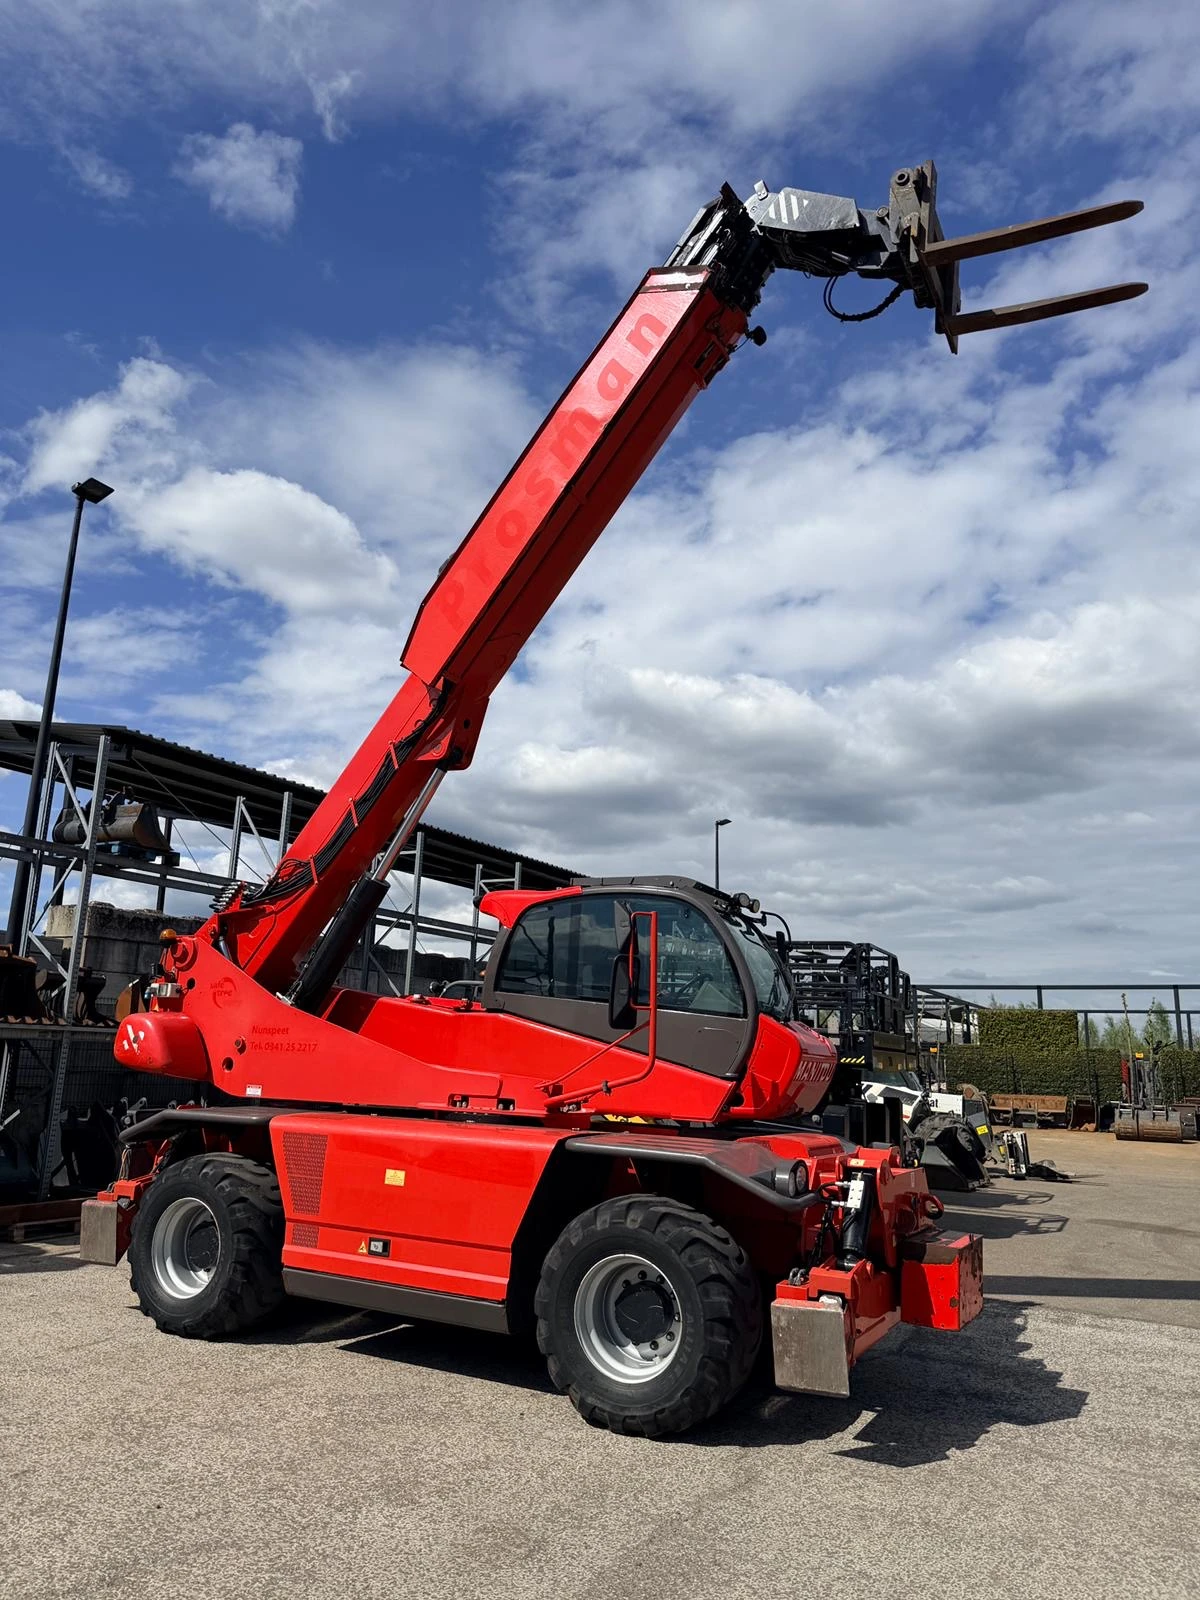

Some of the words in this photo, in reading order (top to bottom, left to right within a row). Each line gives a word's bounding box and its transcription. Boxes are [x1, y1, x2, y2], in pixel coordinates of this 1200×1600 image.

[438, 312, 667, 630] Prosman
[252, 1025, 289, 1036] Nunspeet
[285, 1042, 296, 1052] 25
[297, 1042, 318, 1053] 2217
[793, 1060, 836, 1082] MANITOU
